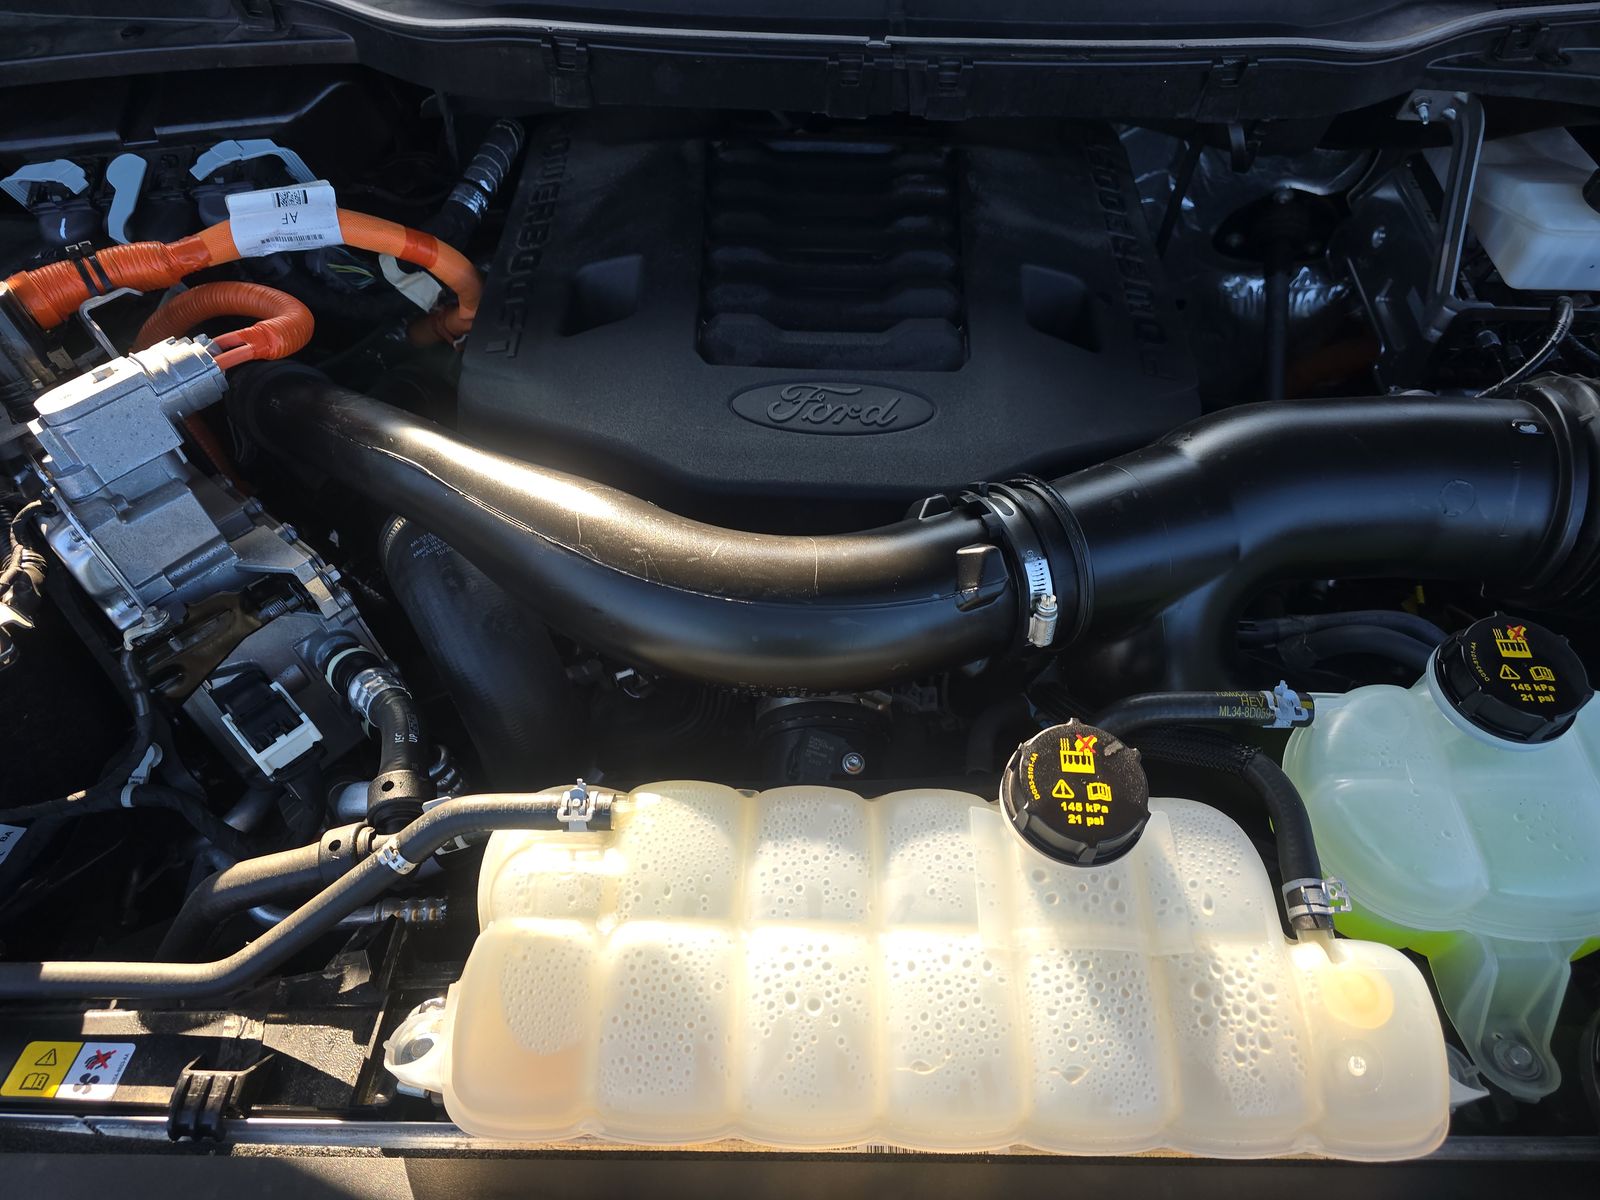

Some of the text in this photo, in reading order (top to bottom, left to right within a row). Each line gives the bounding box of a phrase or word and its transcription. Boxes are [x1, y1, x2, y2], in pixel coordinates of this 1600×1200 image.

[280, 212, 299, 225] AF
[766, 384, 902, 428] Ford
[1510, 683, 1556, 692] 145 kPa
[1240, 696, 1265, 708] HEV
[1520, 693, 1555, 704] 21 psi
[1218, 705, 1276, 720] ML34-8D059-
[1060, 801, 1109, 814] 145 kPa
[1067, 814, 1105, 827] 21 psi
